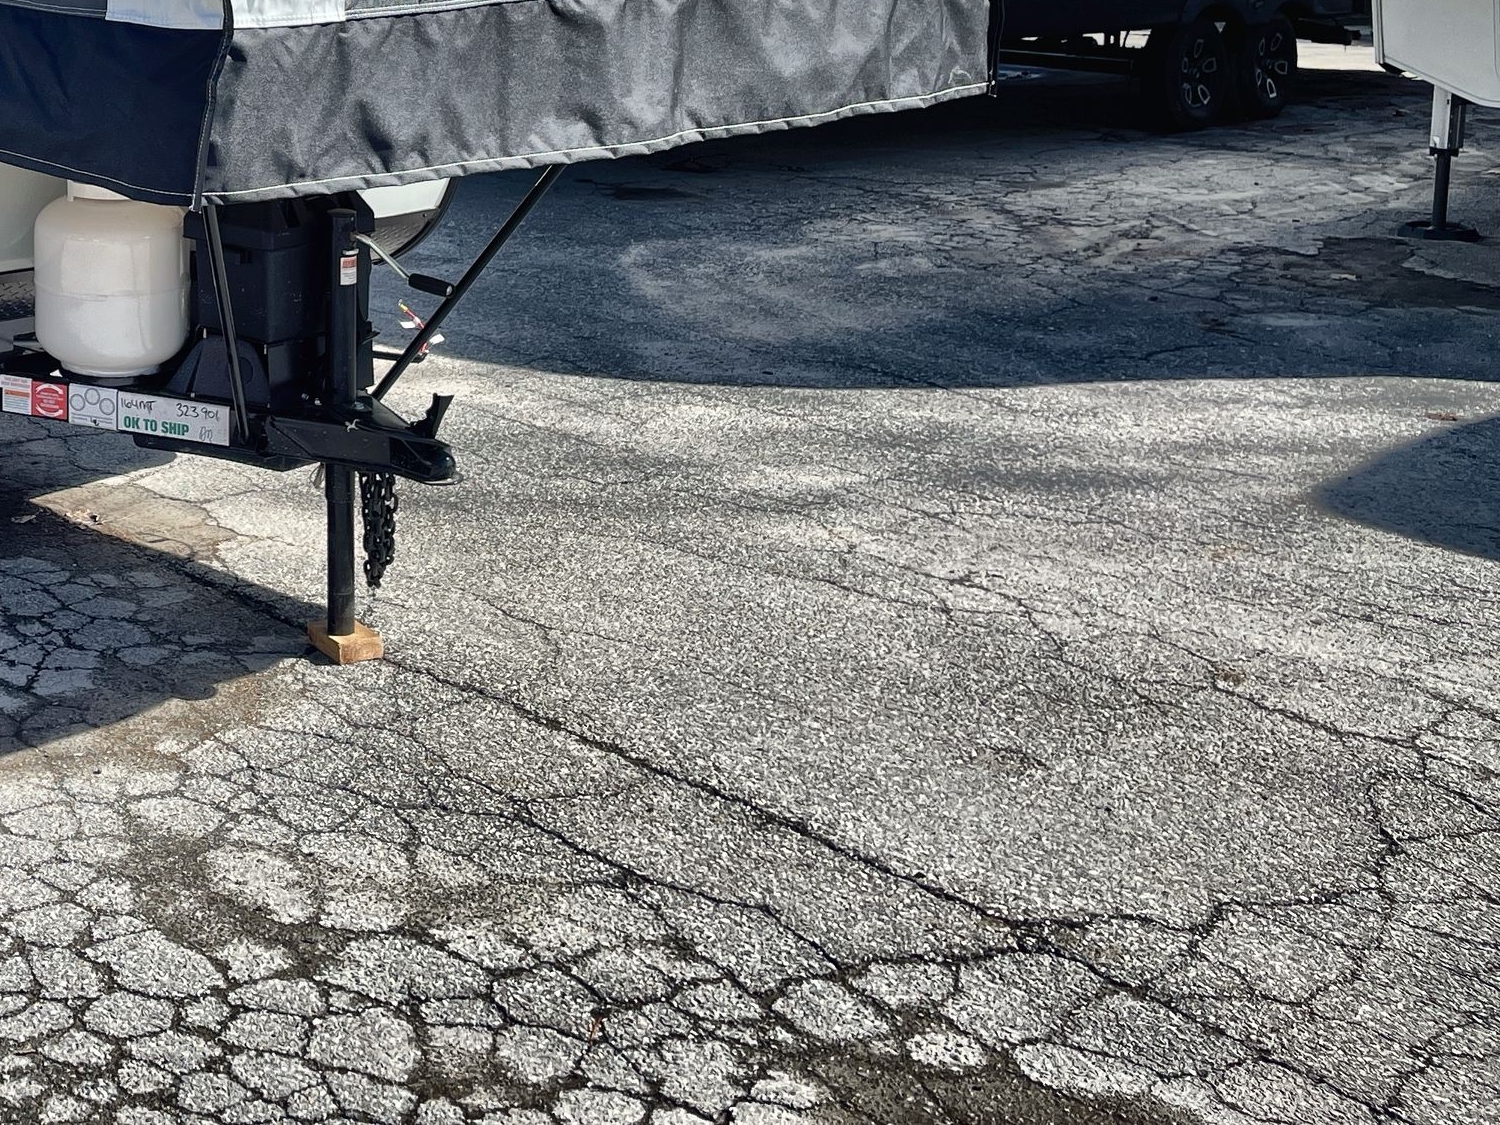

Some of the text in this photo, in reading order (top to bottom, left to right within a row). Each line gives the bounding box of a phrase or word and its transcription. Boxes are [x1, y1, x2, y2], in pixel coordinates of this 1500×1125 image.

[124, 415, 140, 430] OK
[143, 419, 158, 432] TO
[161, 421, 189, 436] SHIP
